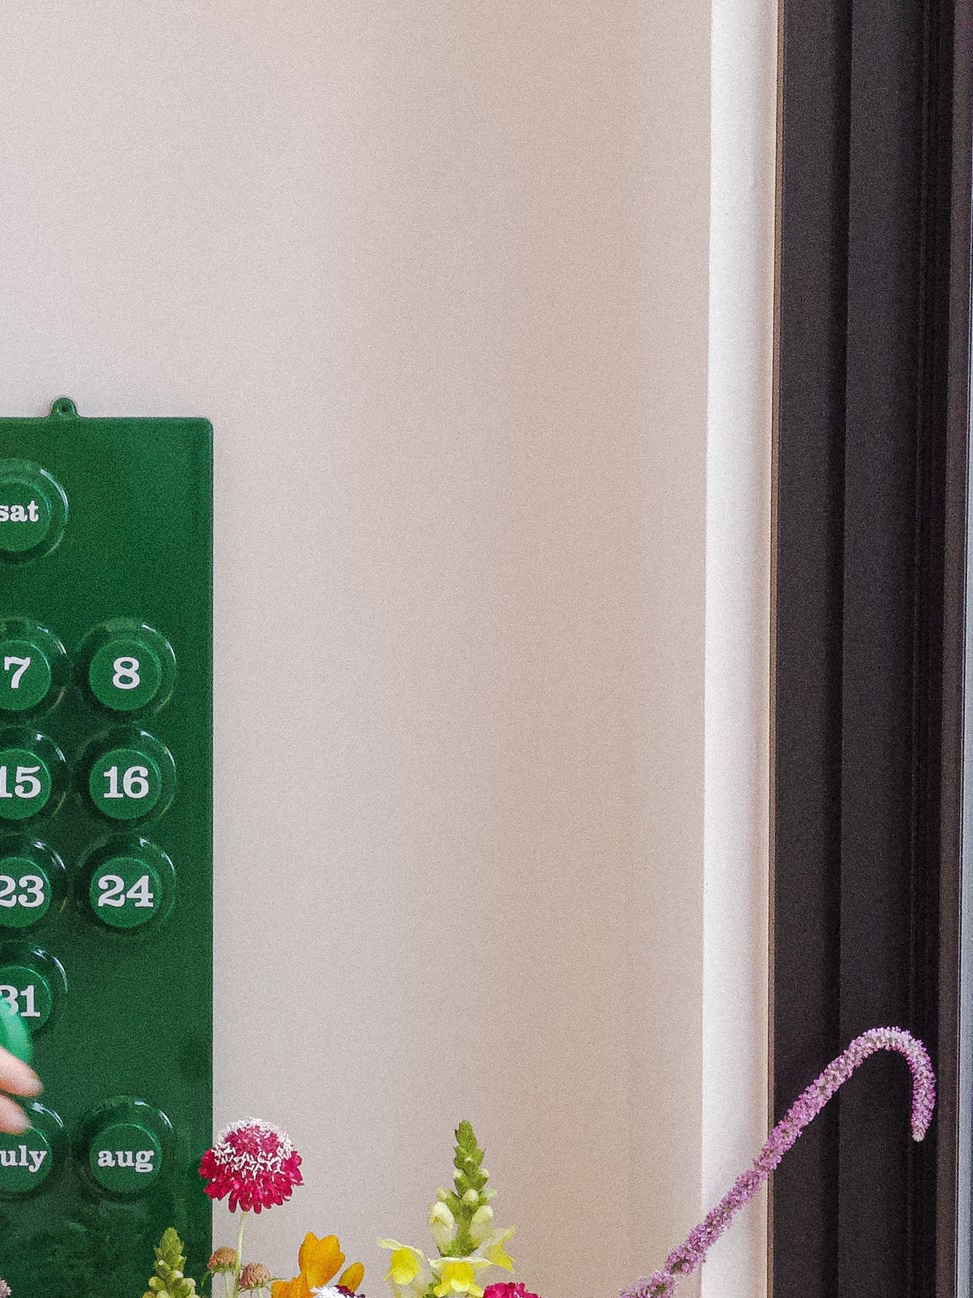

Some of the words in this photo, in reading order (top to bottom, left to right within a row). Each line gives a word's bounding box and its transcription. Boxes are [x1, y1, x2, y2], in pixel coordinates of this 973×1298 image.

[4, 657, 31, 689] 7
[112, 657, 140, 689] 8
[103, 766, 149, 799] 16
[98, 875, 153, 907] 24
[98, 1150, 154, 1172] aug
